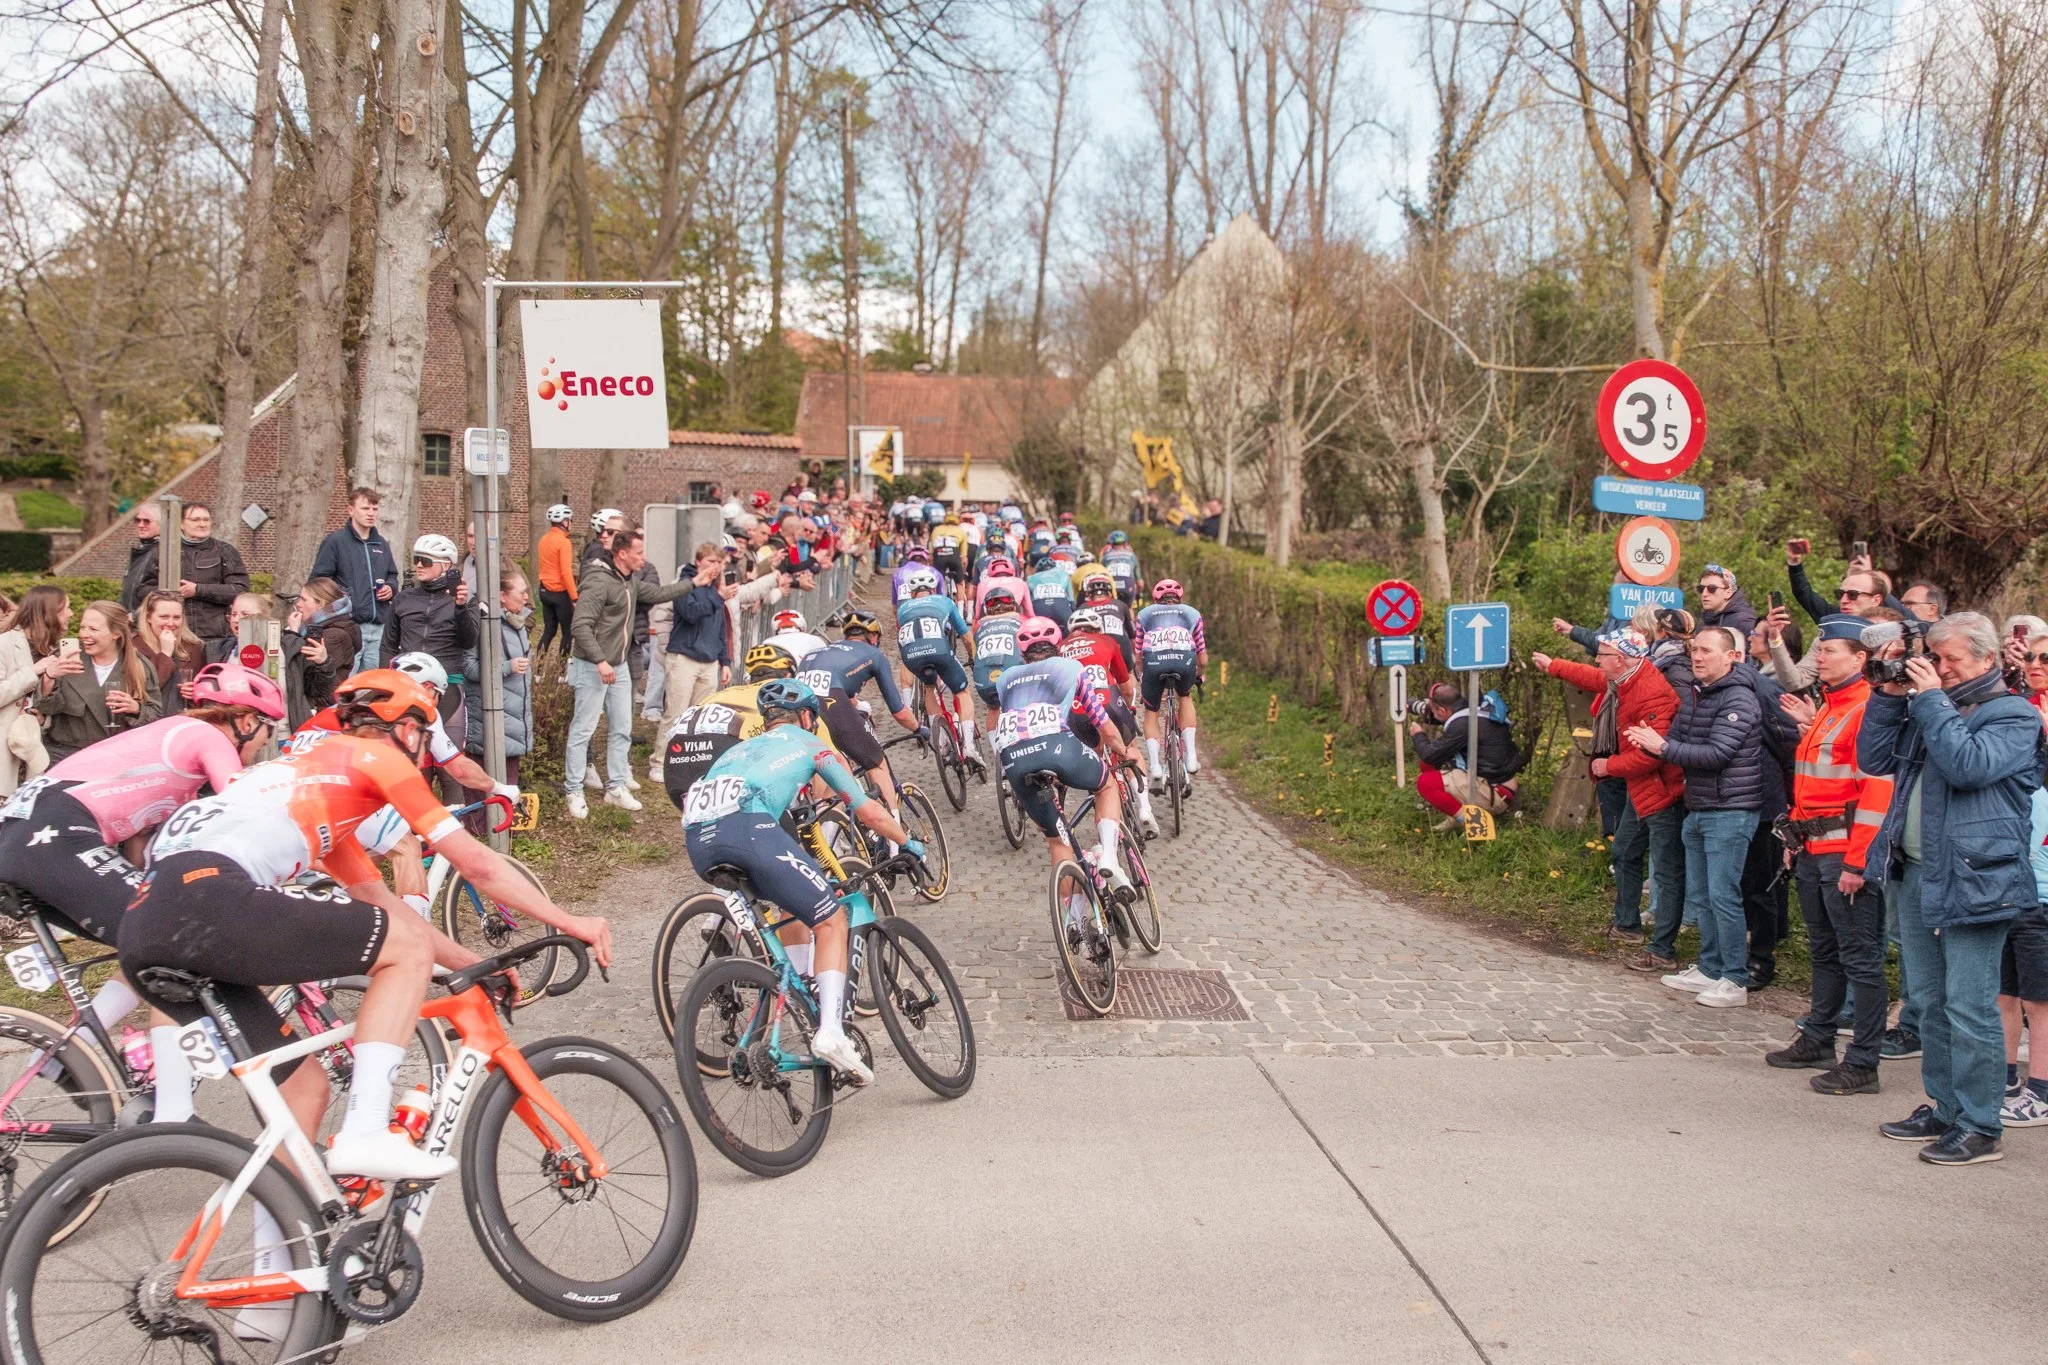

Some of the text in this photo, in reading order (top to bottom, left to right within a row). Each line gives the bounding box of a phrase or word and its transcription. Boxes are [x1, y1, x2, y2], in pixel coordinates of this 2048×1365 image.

[560, 371, 654, 396] Eneco
[1623, 392, 1673, 446] 3 t
[1663, 424, 1678, 450] 5
[1655, 486, 1701, 500] PLAATSELIJK
[1635, 500, 1667, 512] VERKEER
[1620, 588, 1675, 604] VAN 01/04
[1624, 605, 1635, 618] TO
[923, 620, 938, 633] 57
[1172, 630, 1190, 642] 244
[1157, 653, 1184, 661] UNIBET
[805, 673, 830, 690] 195
[1006, 673, 1050, 690] UNIBET
[700, 706, 733, 725] 152
[1027, 704, 1057, 726] 245
[684, 740, 714, 753] VISMA
[1010, 742, 1048, 760] UNIBET
[167, 804, 226, 837] 62
[13, 954, 42, 983] 46
[179, 1029, 216, 1070] 62
